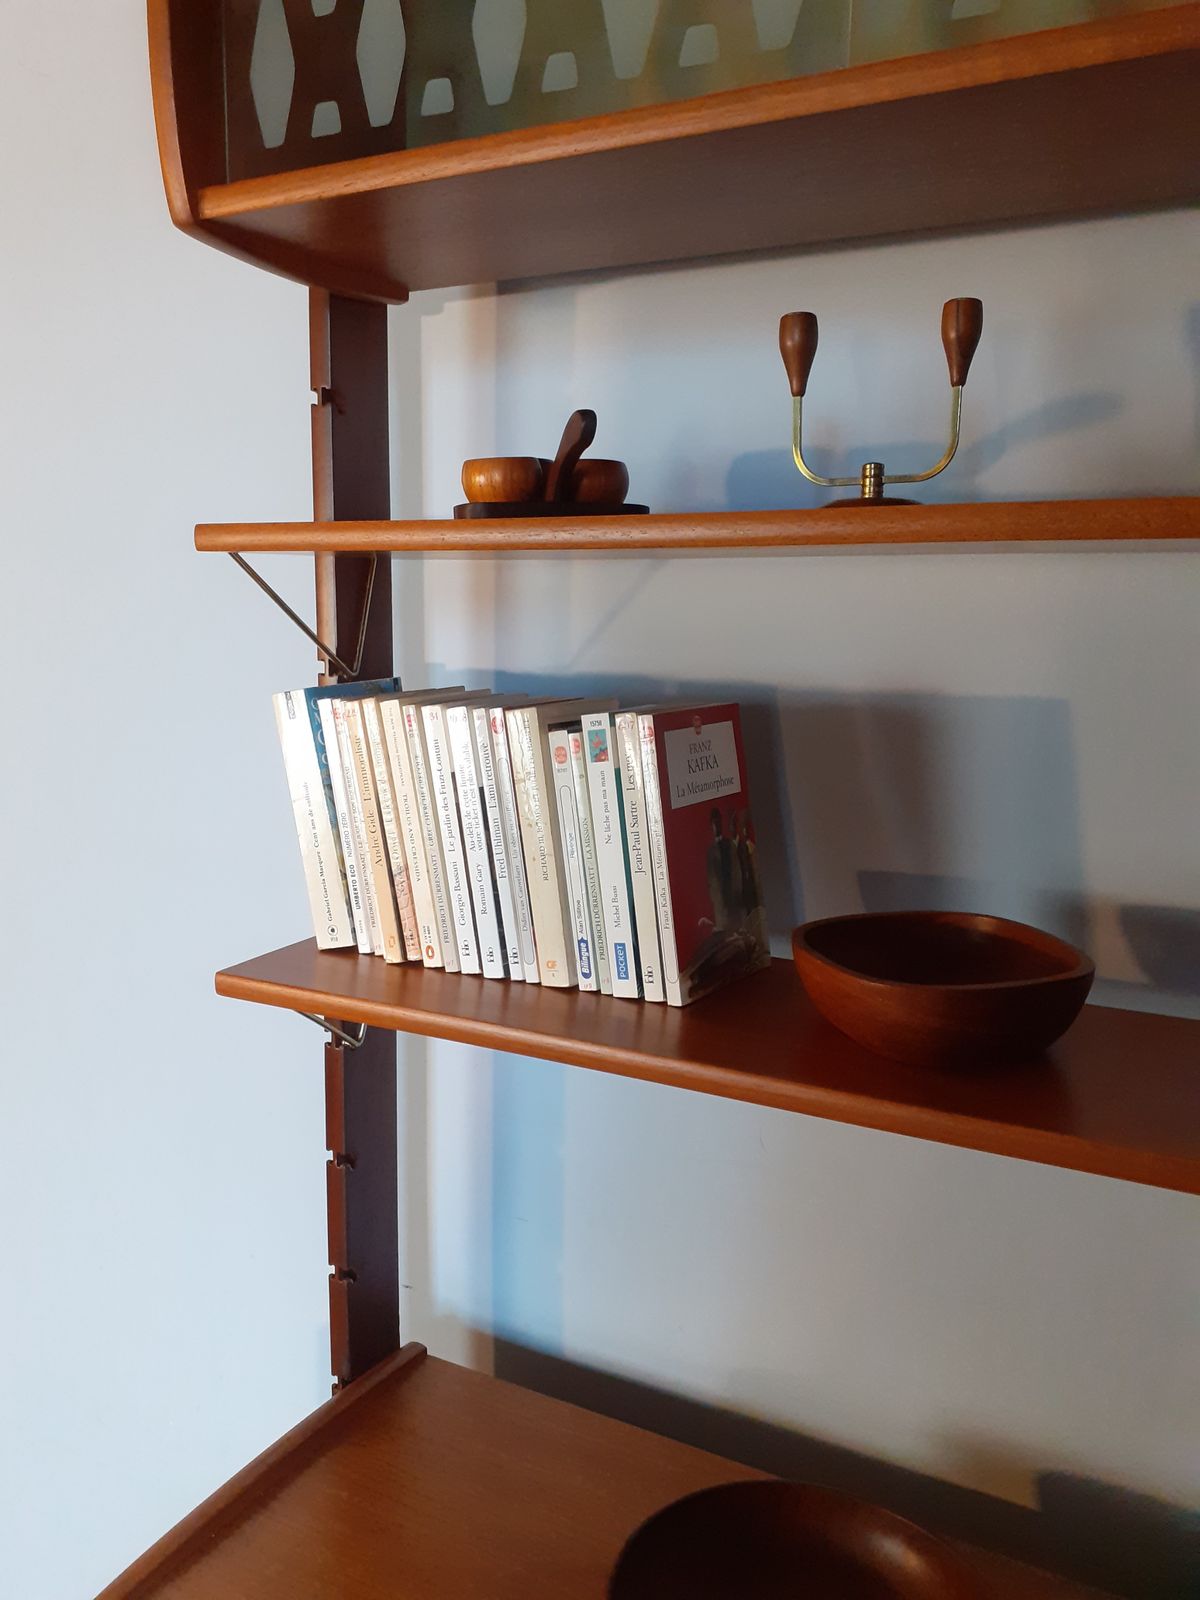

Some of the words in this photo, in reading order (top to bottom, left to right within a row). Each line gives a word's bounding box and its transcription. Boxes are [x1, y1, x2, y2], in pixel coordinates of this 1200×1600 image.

[689, 739, 712, 755] FRANZ
[353, 736, 371, 801] L'immoraliste
[432, 738, 447, 795] Finzi-Contini
[480, 743, 494, 782] retrouvé
[687, 754, 719, 775] KAFKA
[598, 770, 607, 787] main
[625, 775, 635, 791] Les
[676, 785, 686, 798] La
[687, 776, 735, 797] Métamorphose
[440, 797, 449, 812] des
[460, 790, 469, 808] cette
[469, 788, 478, 806] n'est
[487, 784, 497, 809] L'ami
[602, 801, 611, 813] pas
[340, 811, 348, 829] ZÉRO
[367, 810, 377, 834] Gide
[402, 794, 413, 826] TROILUS
[471, 808, 481, 830] ticket
[629, 800, 639, 828] Sartre
[442, 814, 456, 840] jardin
[491, 817, 503, 855] Uhlman
[581, 817, 592, 849] MISSION
[602, 815, 611, 833] lâche
[311, 832, 320, 848] Cent
[342, 830, 352, 858] NUMÉRO
[408, 828, 417, 845] AND
[426, 829, 435, 847] GREC
[447, 841, 455, 852] Le
[463, 822, 476, 852] Au-delà
[474, 832, 484, 851] votre
[567, 832, 576, 859] Revenge
[369, 837, 384, 867] André
[411, 846, 421, 882] CRESSIDA
[538, 846, 549, 881] RICHARD
[630, 831, 646, 876] Jean-Paul
[450, 861, 462, 892] Bassani
[475, 863, 484, 883] Gary
[496, 858, 507, 879] Fred
[351, 879, 361, 910] UMBERTO
[478, 884, 488, 915] Romain
[658, 887, 668, 908] Kafka
[323, 900, 334, 922] Gabriel
[366, 895, 376, 928] FRIEDRICH
[454, 893, 467, 926] Giorgio
[518, 911, 528, 932] Didier
[612, 905, 621, 928] Michel
[660, 910, 670, 930] Franz
[438, 905, 449, 944] FRIEDRICH
[575, 920, 584, 934] Alan
[594, 920, 606, 960] FRIEDRICH
[579, 942, 591, 974] Bilingue
[617, 944, 627, 978] POCKET
